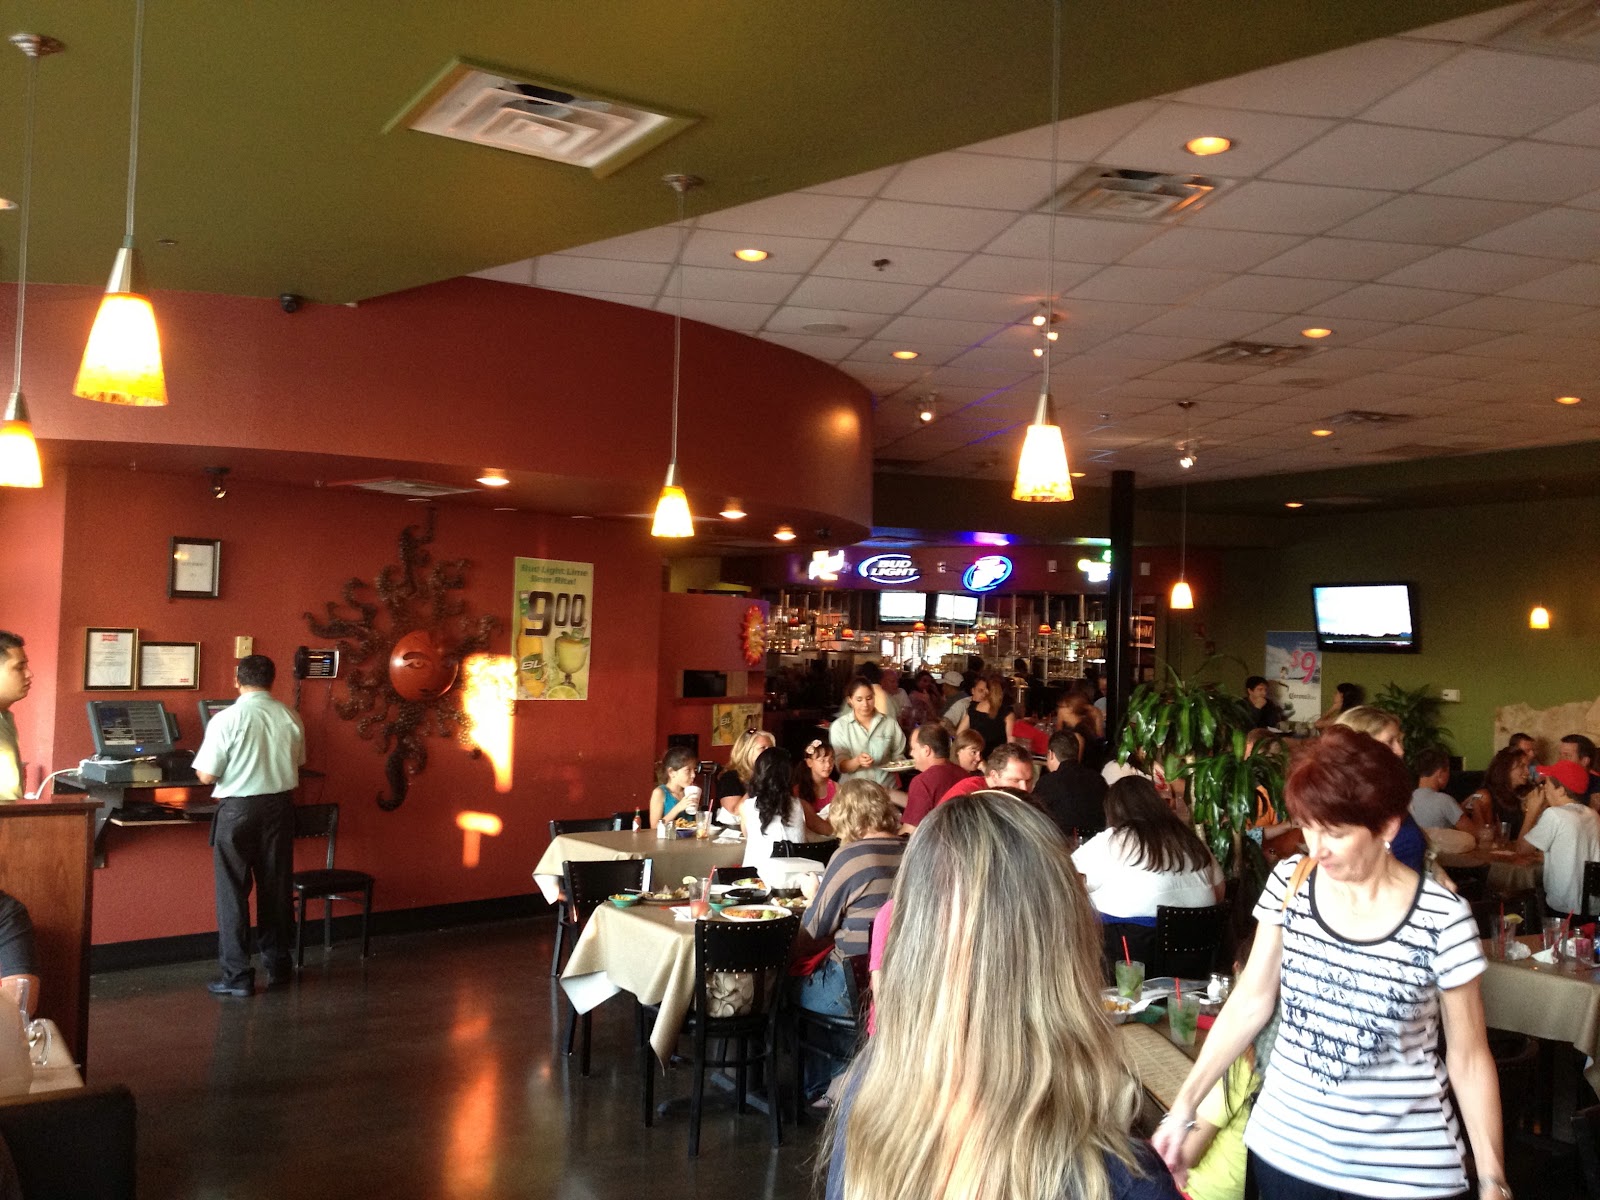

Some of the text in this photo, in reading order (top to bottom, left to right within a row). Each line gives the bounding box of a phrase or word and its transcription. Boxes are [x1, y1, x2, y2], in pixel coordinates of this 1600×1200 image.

[877, 559, 913, 568] BUD
[521, 564, 589, 577] Bud Light Lime
[870, 567, 918, 576] LIGHT
